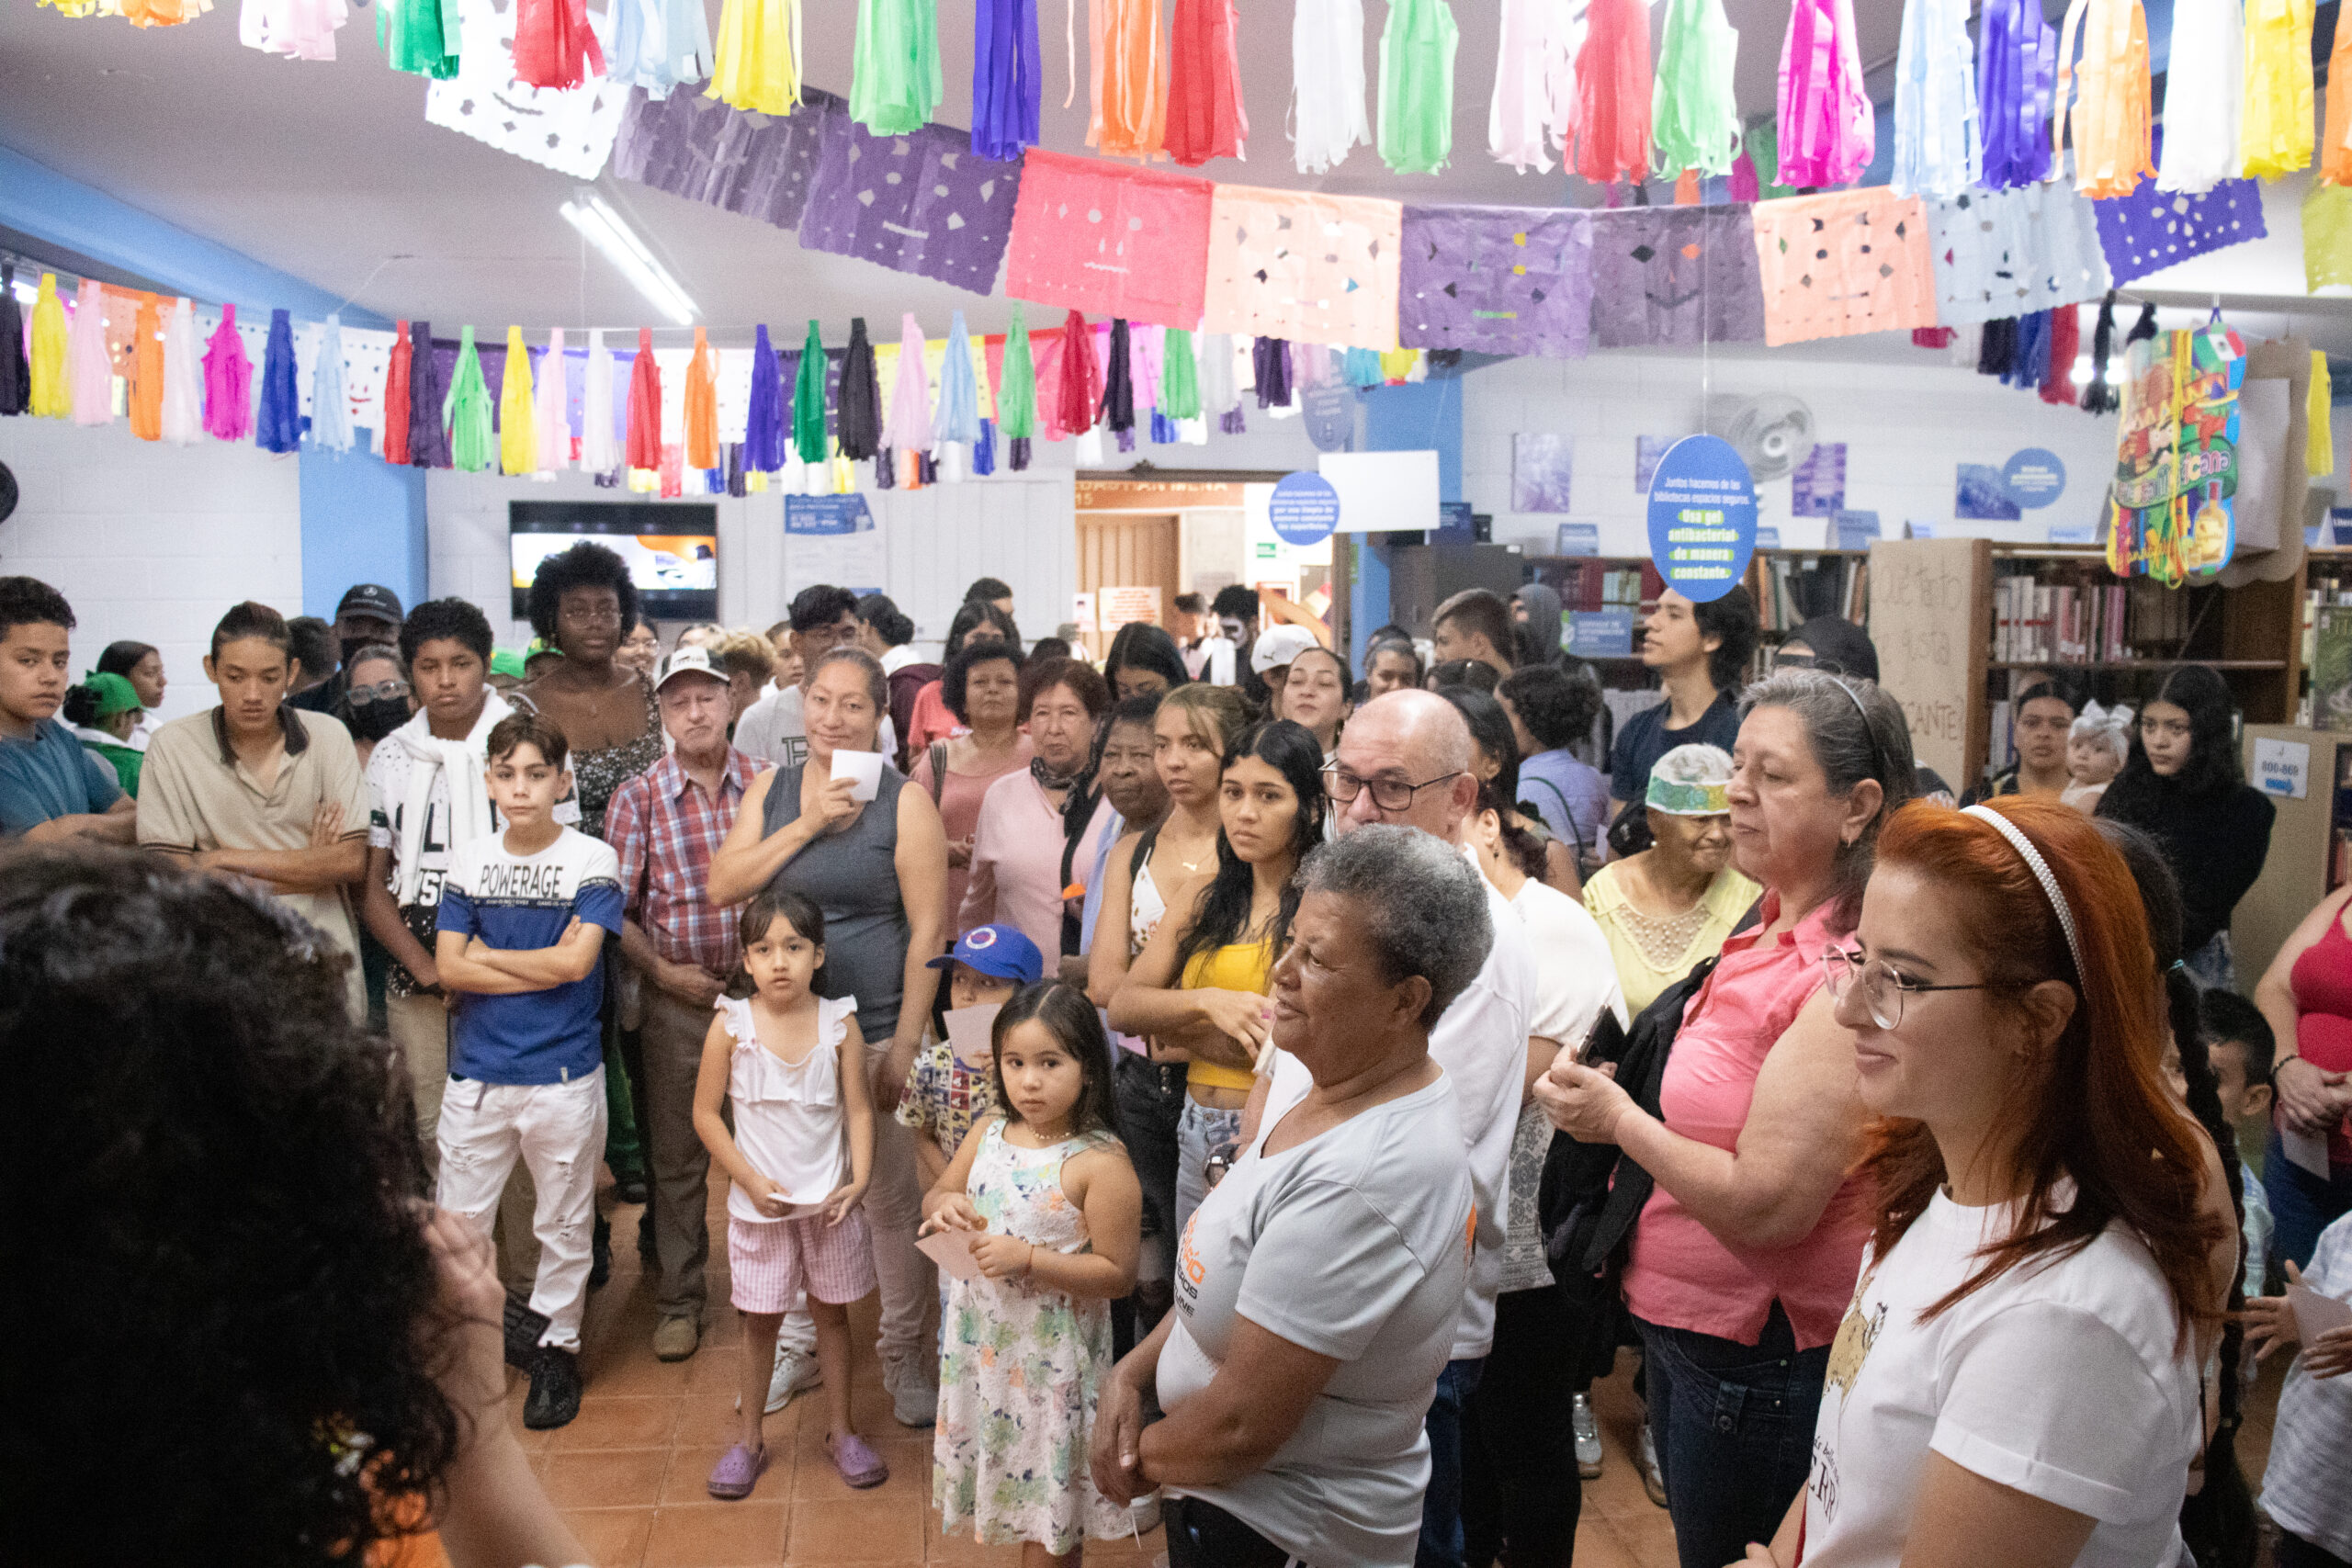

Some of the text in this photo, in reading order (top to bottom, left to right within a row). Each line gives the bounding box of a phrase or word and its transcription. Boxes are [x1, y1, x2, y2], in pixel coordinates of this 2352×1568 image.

[1689, 478, 1719, 490] hacemos
[1721, 479, 1729, 490] de
[1691, 493, 1721, 504] espacios
[1682, 509, 1722, 525] Usa gel
[1668, 527, 1736, 543] antibacterial
[1674, 546, 1729, 561] de manera
[1674, 566, 1729, 580] constante.
[479, 863, 564, 898] POWERAGE
